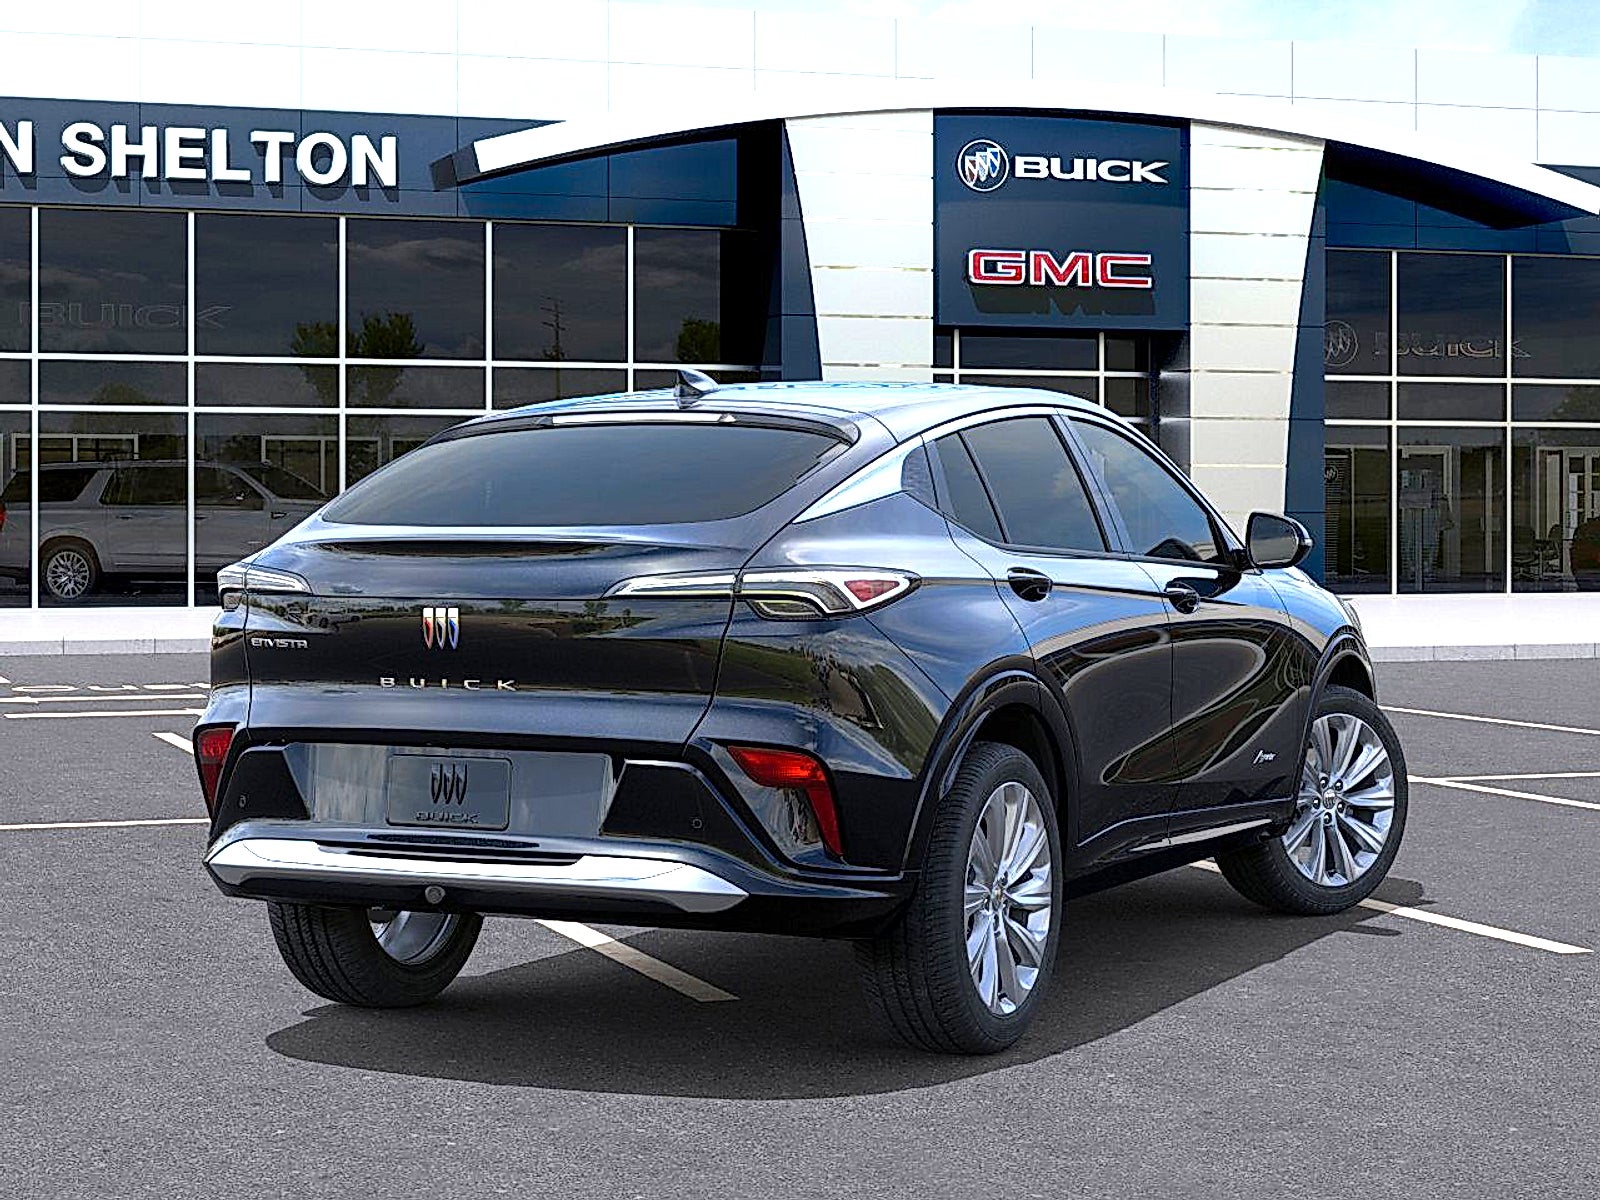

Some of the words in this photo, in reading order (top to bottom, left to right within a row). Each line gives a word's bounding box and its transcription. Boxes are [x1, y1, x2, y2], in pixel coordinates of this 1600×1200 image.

[60, 122, 397, 187] SHELTON
[1014, 155, 1170, 184] BUICK
[968, 249, 1153, 289] GMC
[379, 677, 517, 692] BUICK
